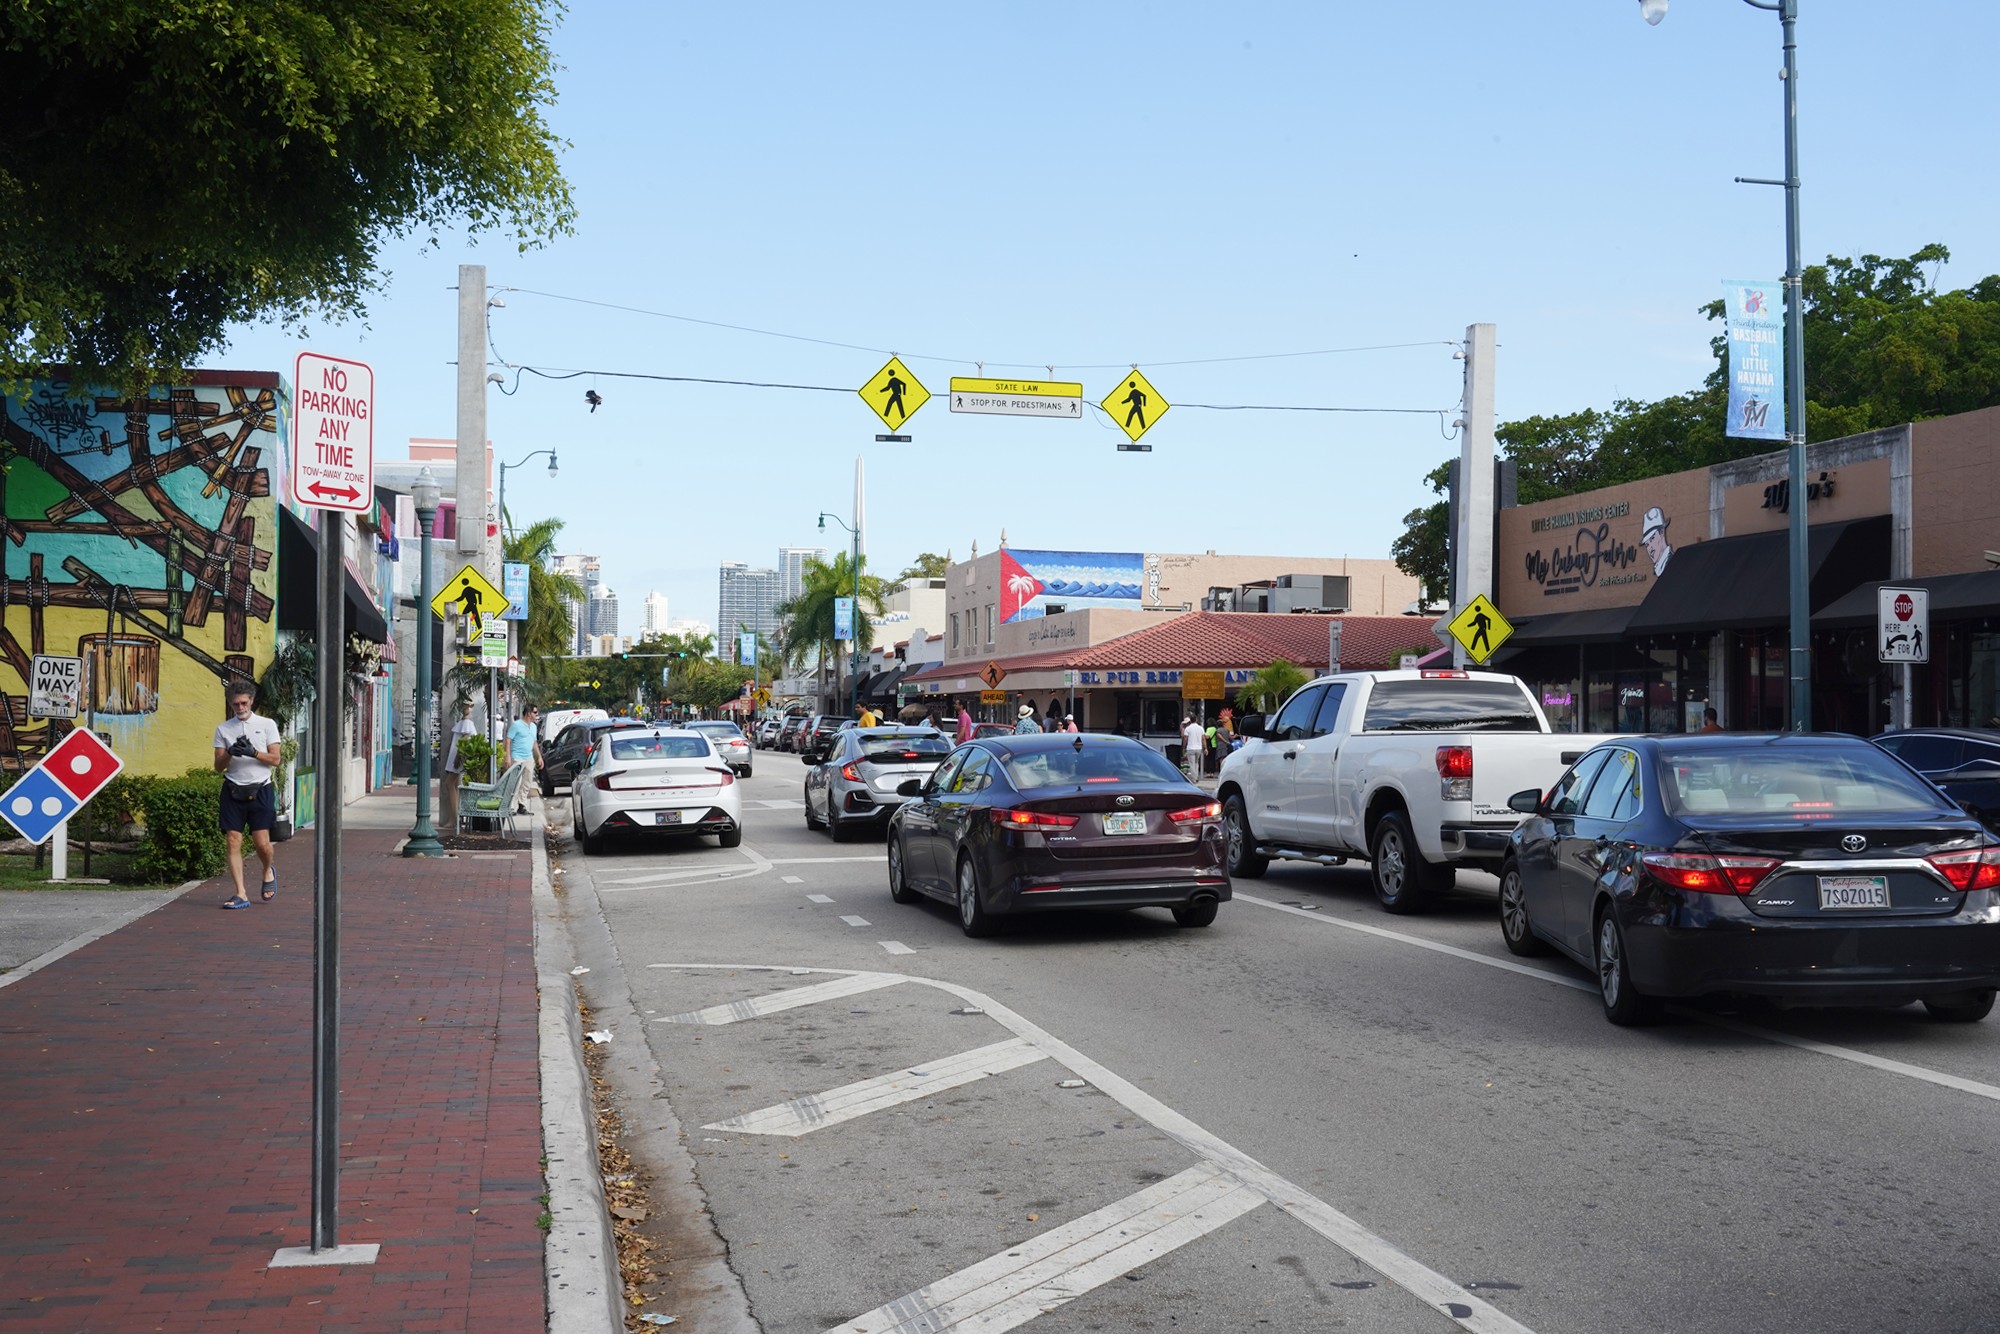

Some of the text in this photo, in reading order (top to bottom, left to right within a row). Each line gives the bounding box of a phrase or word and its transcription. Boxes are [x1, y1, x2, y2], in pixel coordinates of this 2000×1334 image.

[1733, 328, 1777, 344] BASEBALL
[1750, 344, 1760, 356] IS
[1742, 357, 1768, 371] LITTLE
[323, 367, 347, 392] NO
[1737, 370, 1775, 386] HAVANA
[995, 383, 1017, 392] STATE
[302, 389, 367, 420] PARKING
[970, 398, 989, 406] STOP
[1011, 401, 1062, 410] PEDESTRIANS
[318, 417, 351, 441] ANY
[314, 442, 353, 468] TIME
[302, 465, 365, 483] TOW-AWAY ZONE
[1531, 502, 1630, 533] LITTLE HAVANA VISITORS CENTER
[1526, 523, 1637, 587] My Cuban Fedora
[1895, 601, 1913, 613] STOP
[1885, 623, 1901, 633] HERE
[1898, 644, 1911, 654] FOR
[39, 660, 75, 677] ONE
[37, 677, 75, 693] WAY
[1080, 671, 1101, 684] EL
[1107, 671, 1139, 683] PUB
[983, 693, 1004, 701] AHEAD
[1832, 878, 1872, 888] California
[1823, 888, 1884, 905] 7SQZ015
